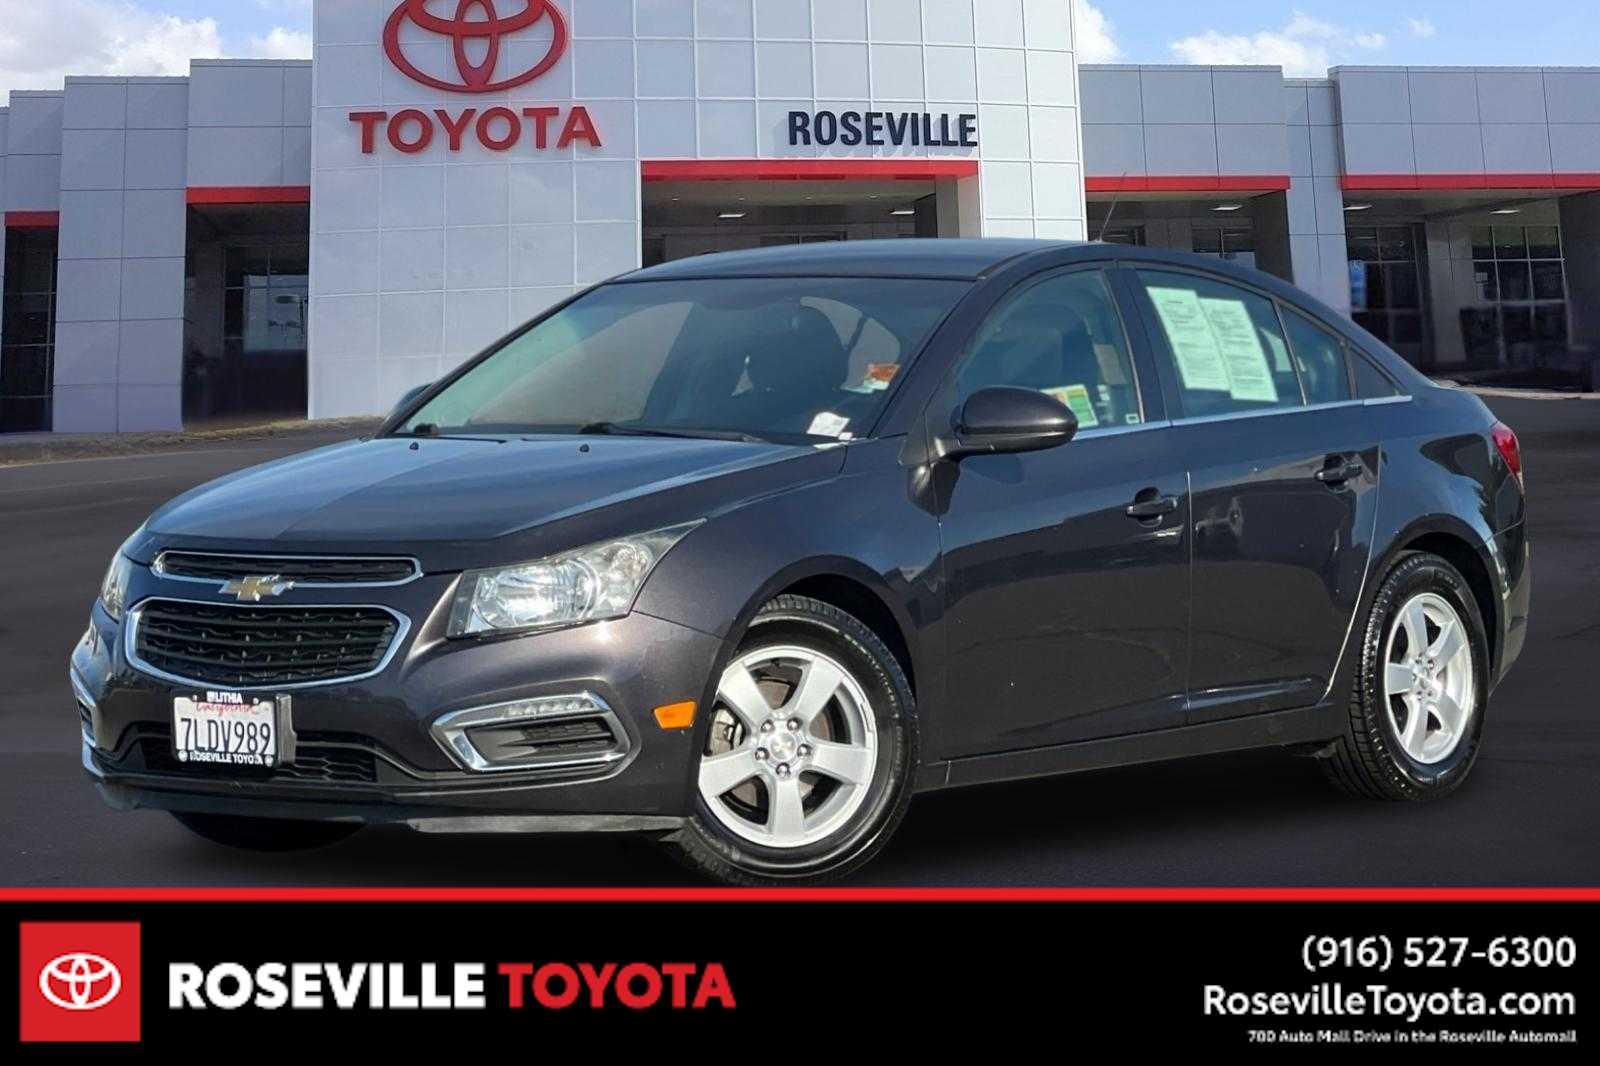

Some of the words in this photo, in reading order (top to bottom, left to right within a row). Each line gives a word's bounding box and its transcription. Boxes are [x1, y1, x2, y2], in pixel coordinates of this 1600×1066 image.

[349, 105, 602, 154] TOYOTA
[788, 110, 979, 148] ROSEVILLE
[180, 718, 271, 755] 7LDV989
[189, 751, 232, 763] ROSEVILLE
[233, 753, 264, 766] TOYOTA
